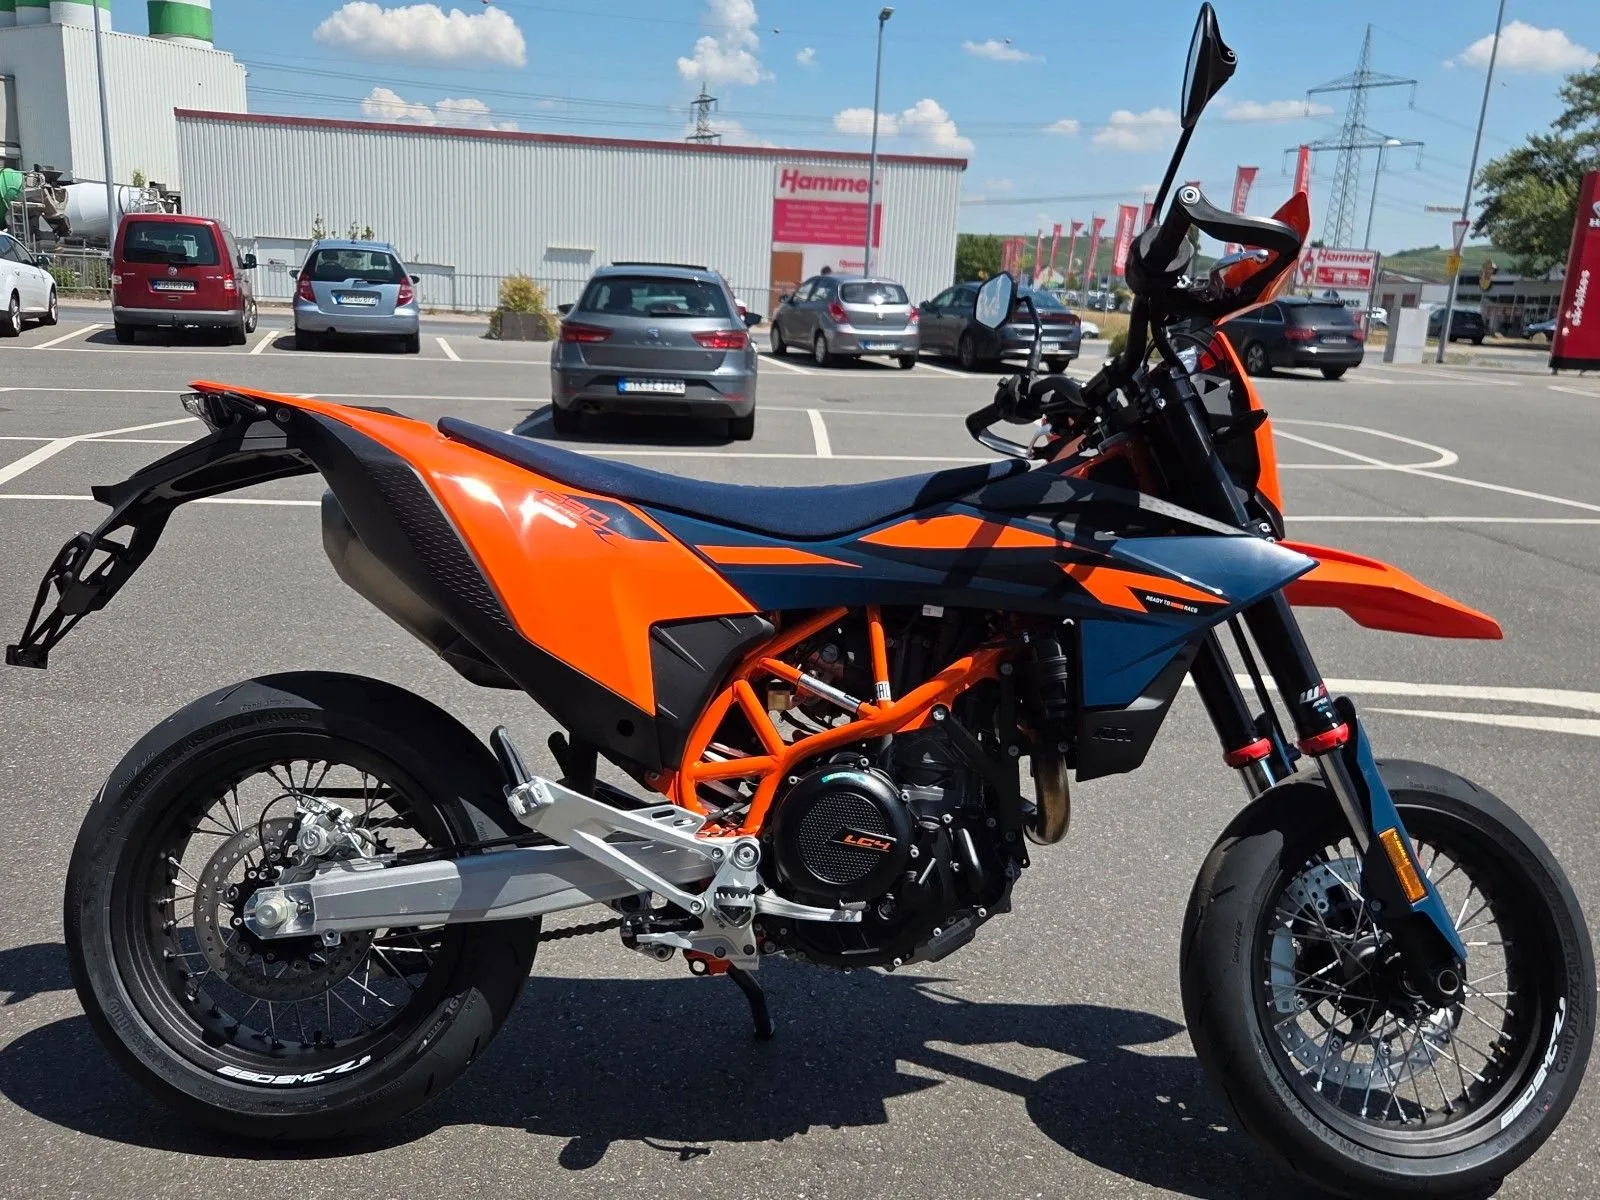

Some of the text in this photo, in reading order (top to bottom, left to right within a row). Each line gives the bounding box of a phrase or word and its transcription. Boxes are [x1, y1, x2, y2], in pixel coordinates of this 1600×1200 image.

[780, 168, 879, 194] Hamme
[1318, 249, 1373, 263] Hammer
[1145, 595, 1163, 604] READY
[1183, 605, 1198, 613] RACE
[844, 834, 890, 850] LC4
